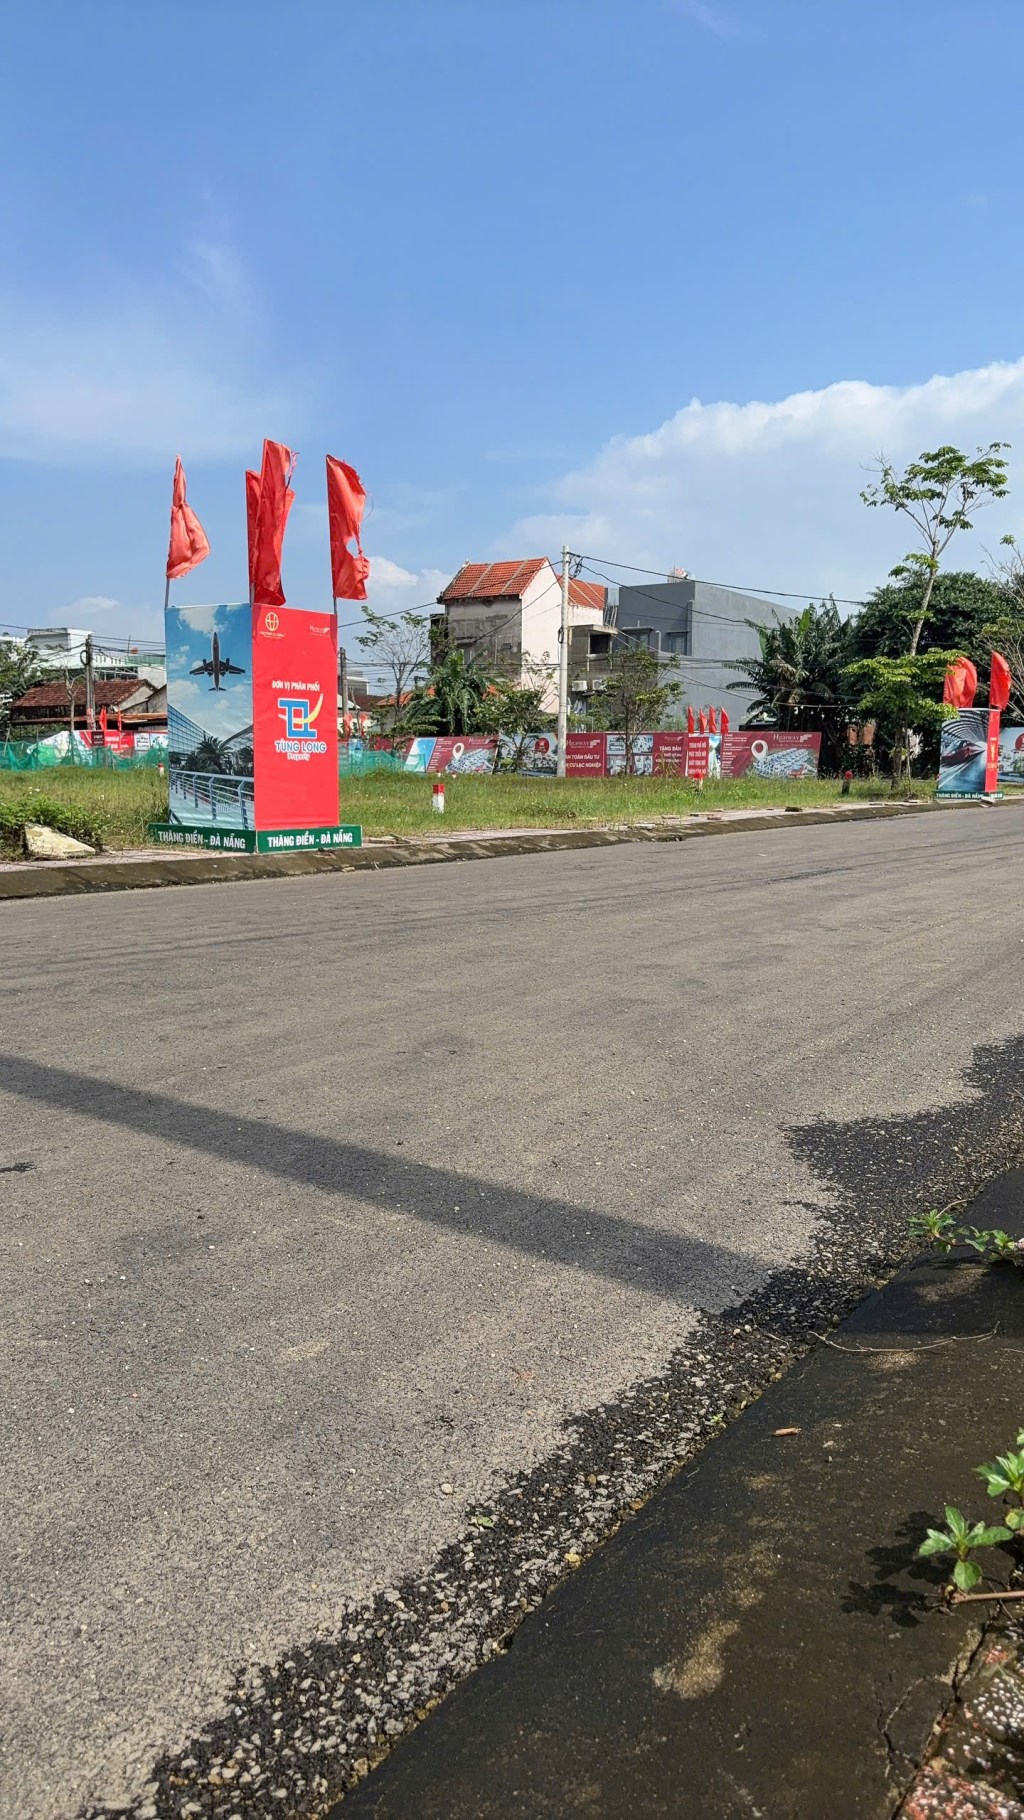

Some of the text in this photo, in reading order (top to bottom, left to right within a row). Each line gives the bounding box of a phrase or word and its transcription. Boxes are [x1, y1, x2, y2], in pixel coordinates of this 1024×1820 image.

[275, 738, 327, 753] TÙNG LONG
[210, 833, 220, 846] ĐÀ
[223, 833, 246, 849] NẴNG
[320, 831, 331, 844] ĐÀ
[333, 829, 353, 843] NẴNG
